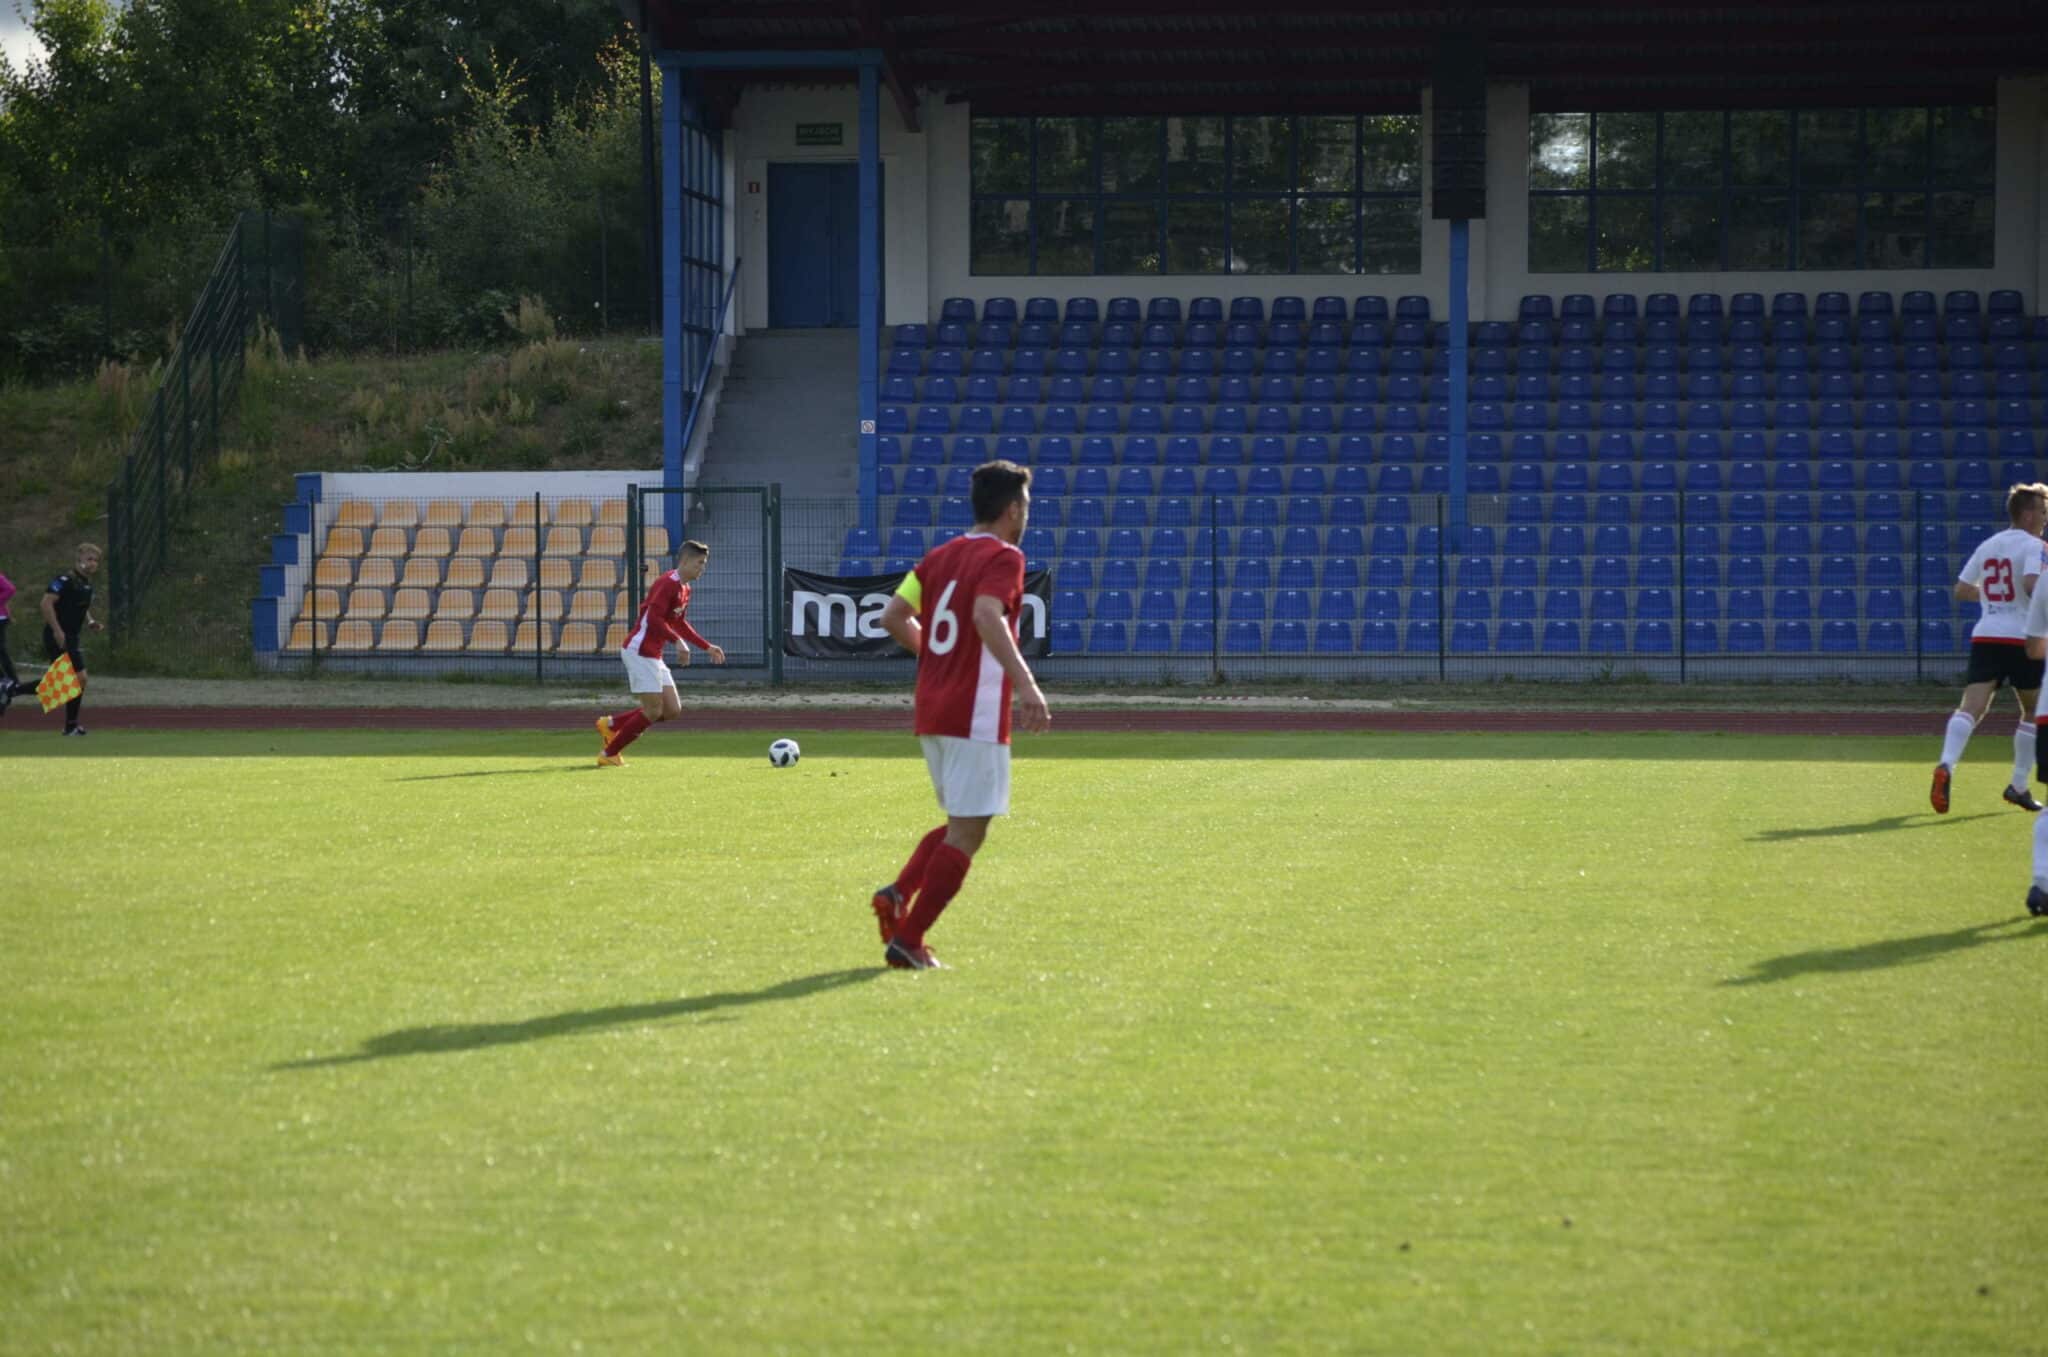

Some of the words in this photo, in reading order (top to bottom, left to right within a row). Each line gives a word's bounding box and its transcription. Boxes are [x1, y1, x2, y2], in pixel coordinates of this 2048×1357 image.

[1983, 558, 2015, 602] 23
[792, 590, 1046, 638] man
[928, 580, 959, 655] 6
